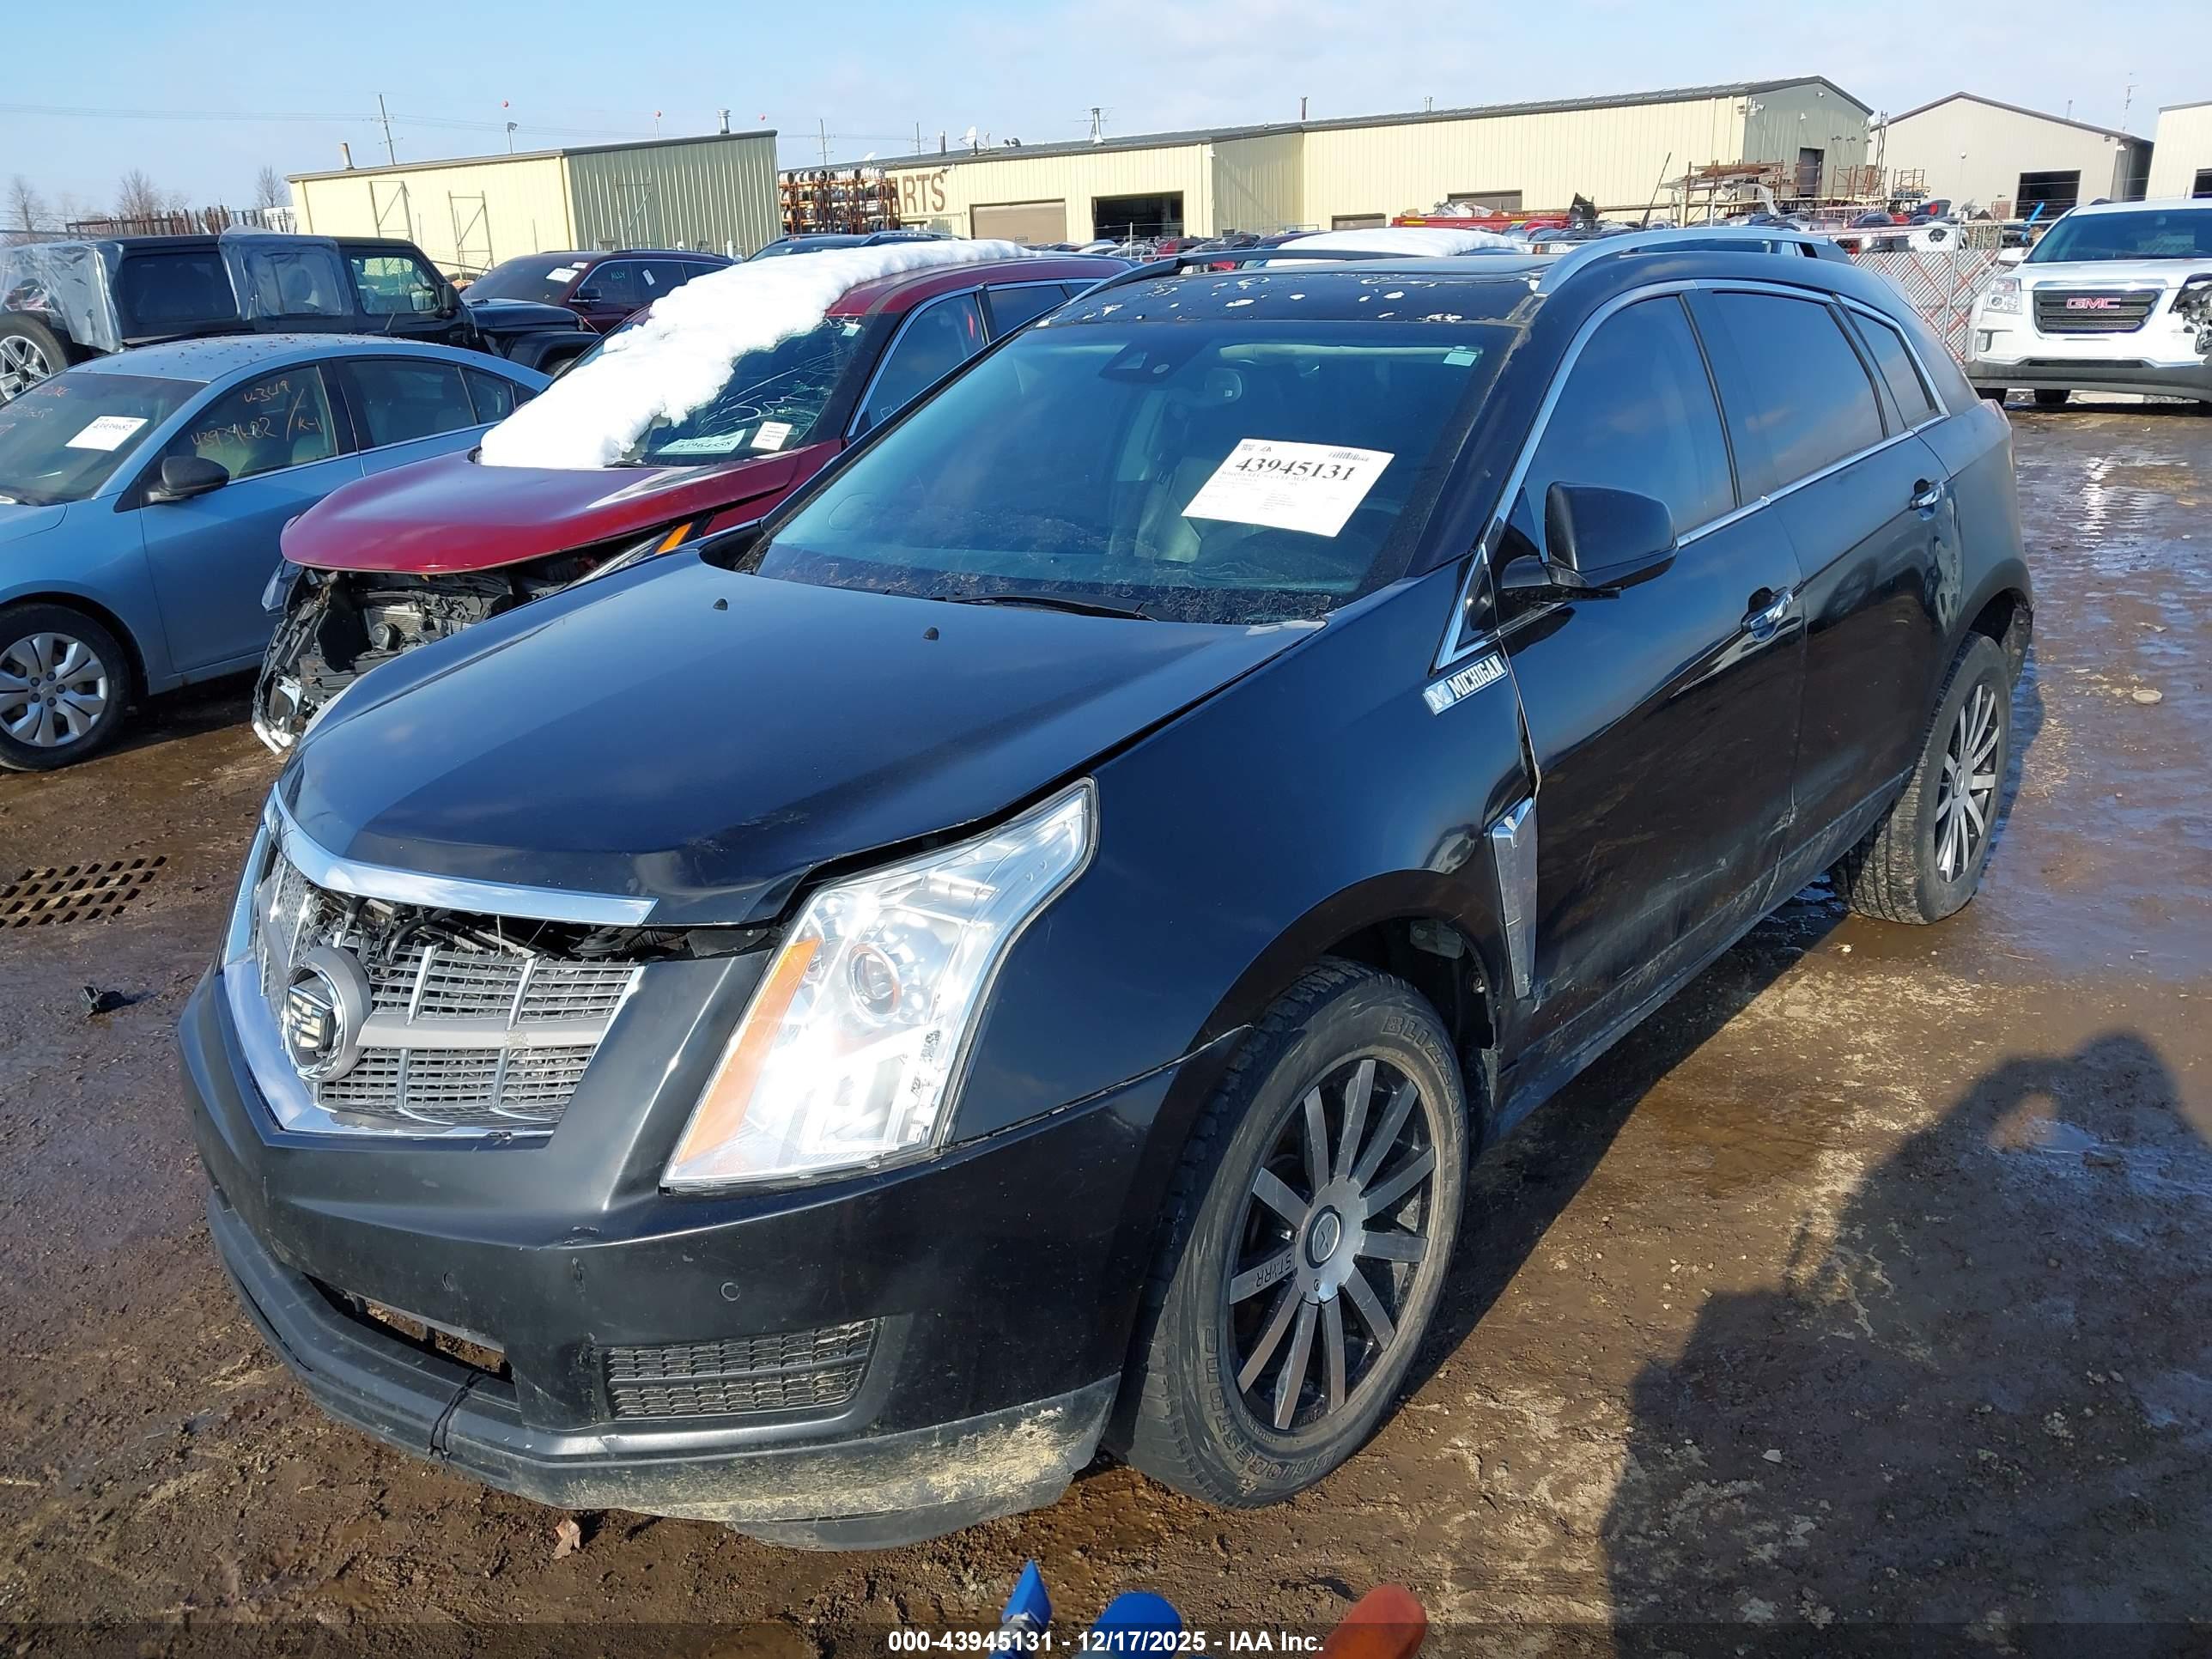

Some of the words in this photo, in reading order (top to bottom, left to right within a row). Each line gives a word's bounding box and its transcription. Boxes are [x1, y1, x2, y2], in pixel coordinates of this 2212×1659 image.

[2066, 297, 2122, 309] GMC
[1236, 457, 1357, 482] 43945131
[1426, 684, 1454, 709] M
[1446, 654, 1506, 699] MICHIGAN
